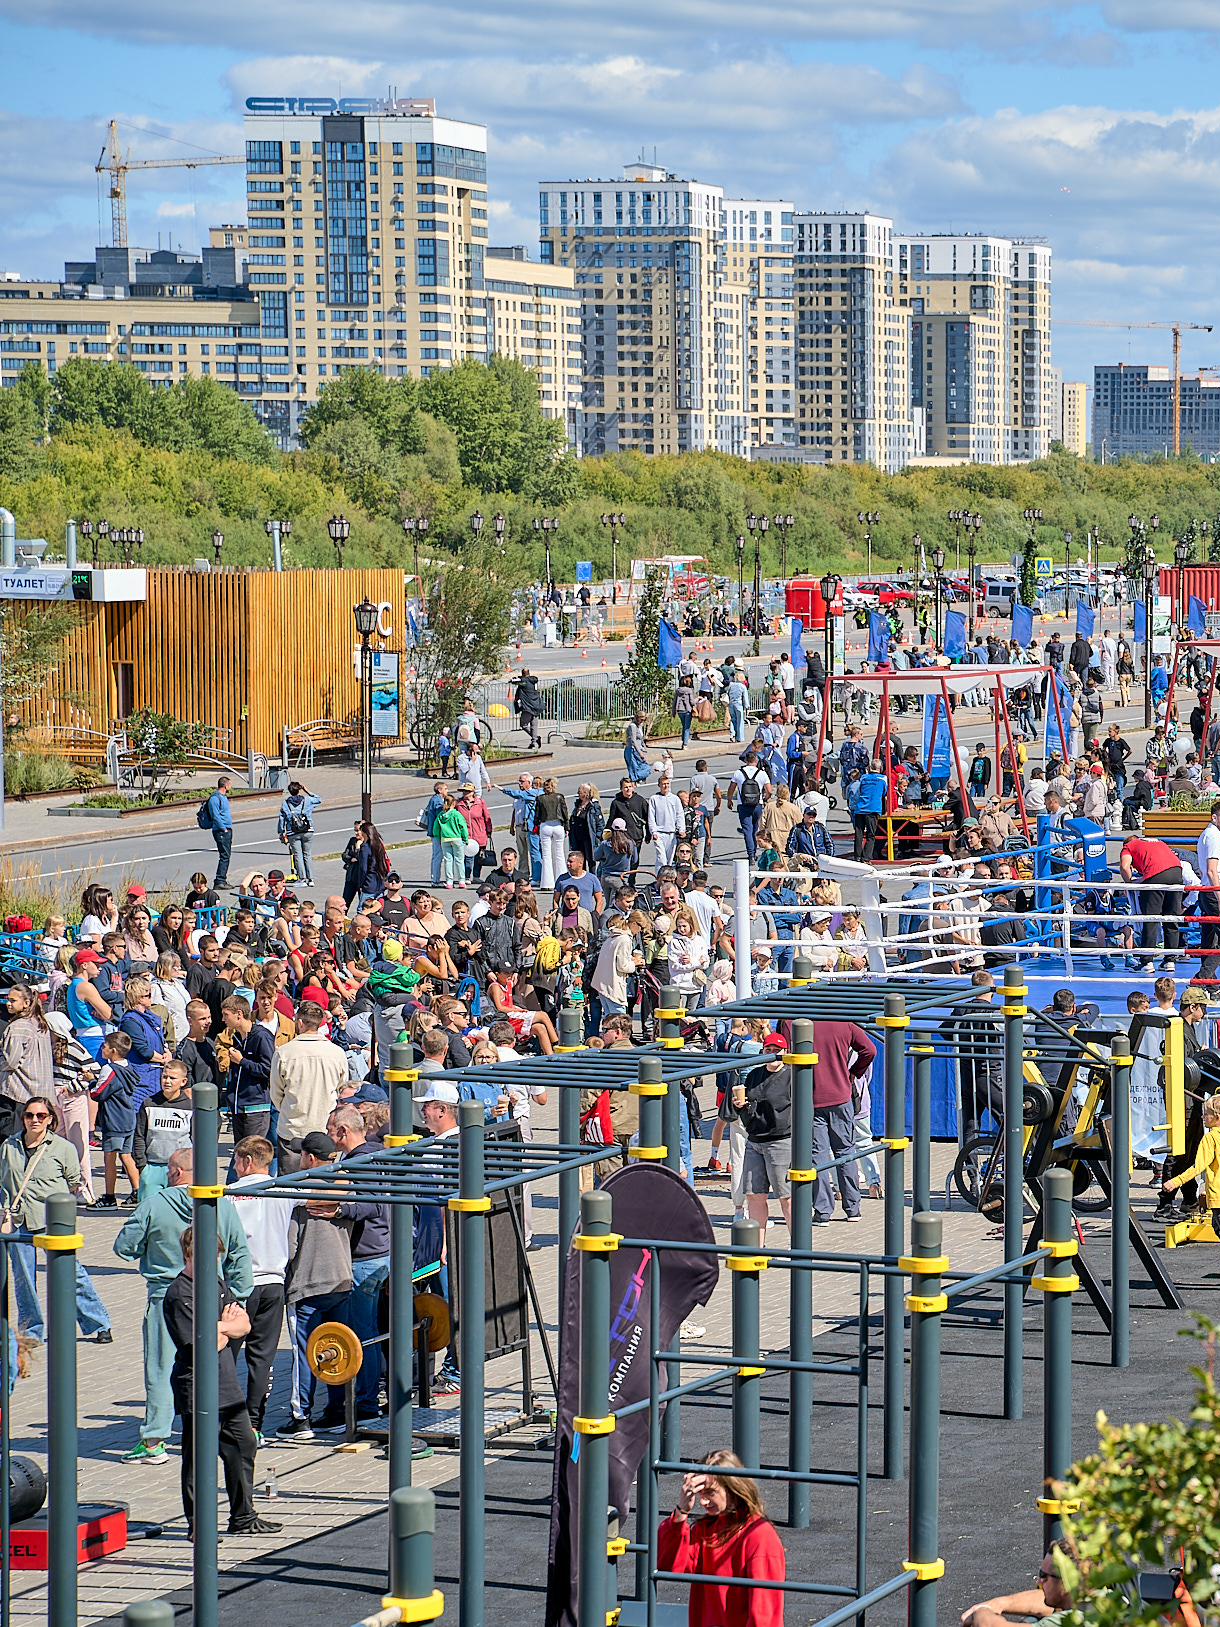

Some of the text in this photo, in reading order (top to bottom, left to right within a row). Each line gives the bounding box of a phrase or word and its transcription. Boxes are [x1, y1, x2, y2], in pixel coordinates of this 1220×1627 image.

[3, 579, 45, 588] ТУАЛЕТ
[1130, 1096, 1158, 1104] ОРОДА
[154, 1118, 182, 1129] PUMA
[607, 1325, 643, 1402] КОМПАНИЯ
